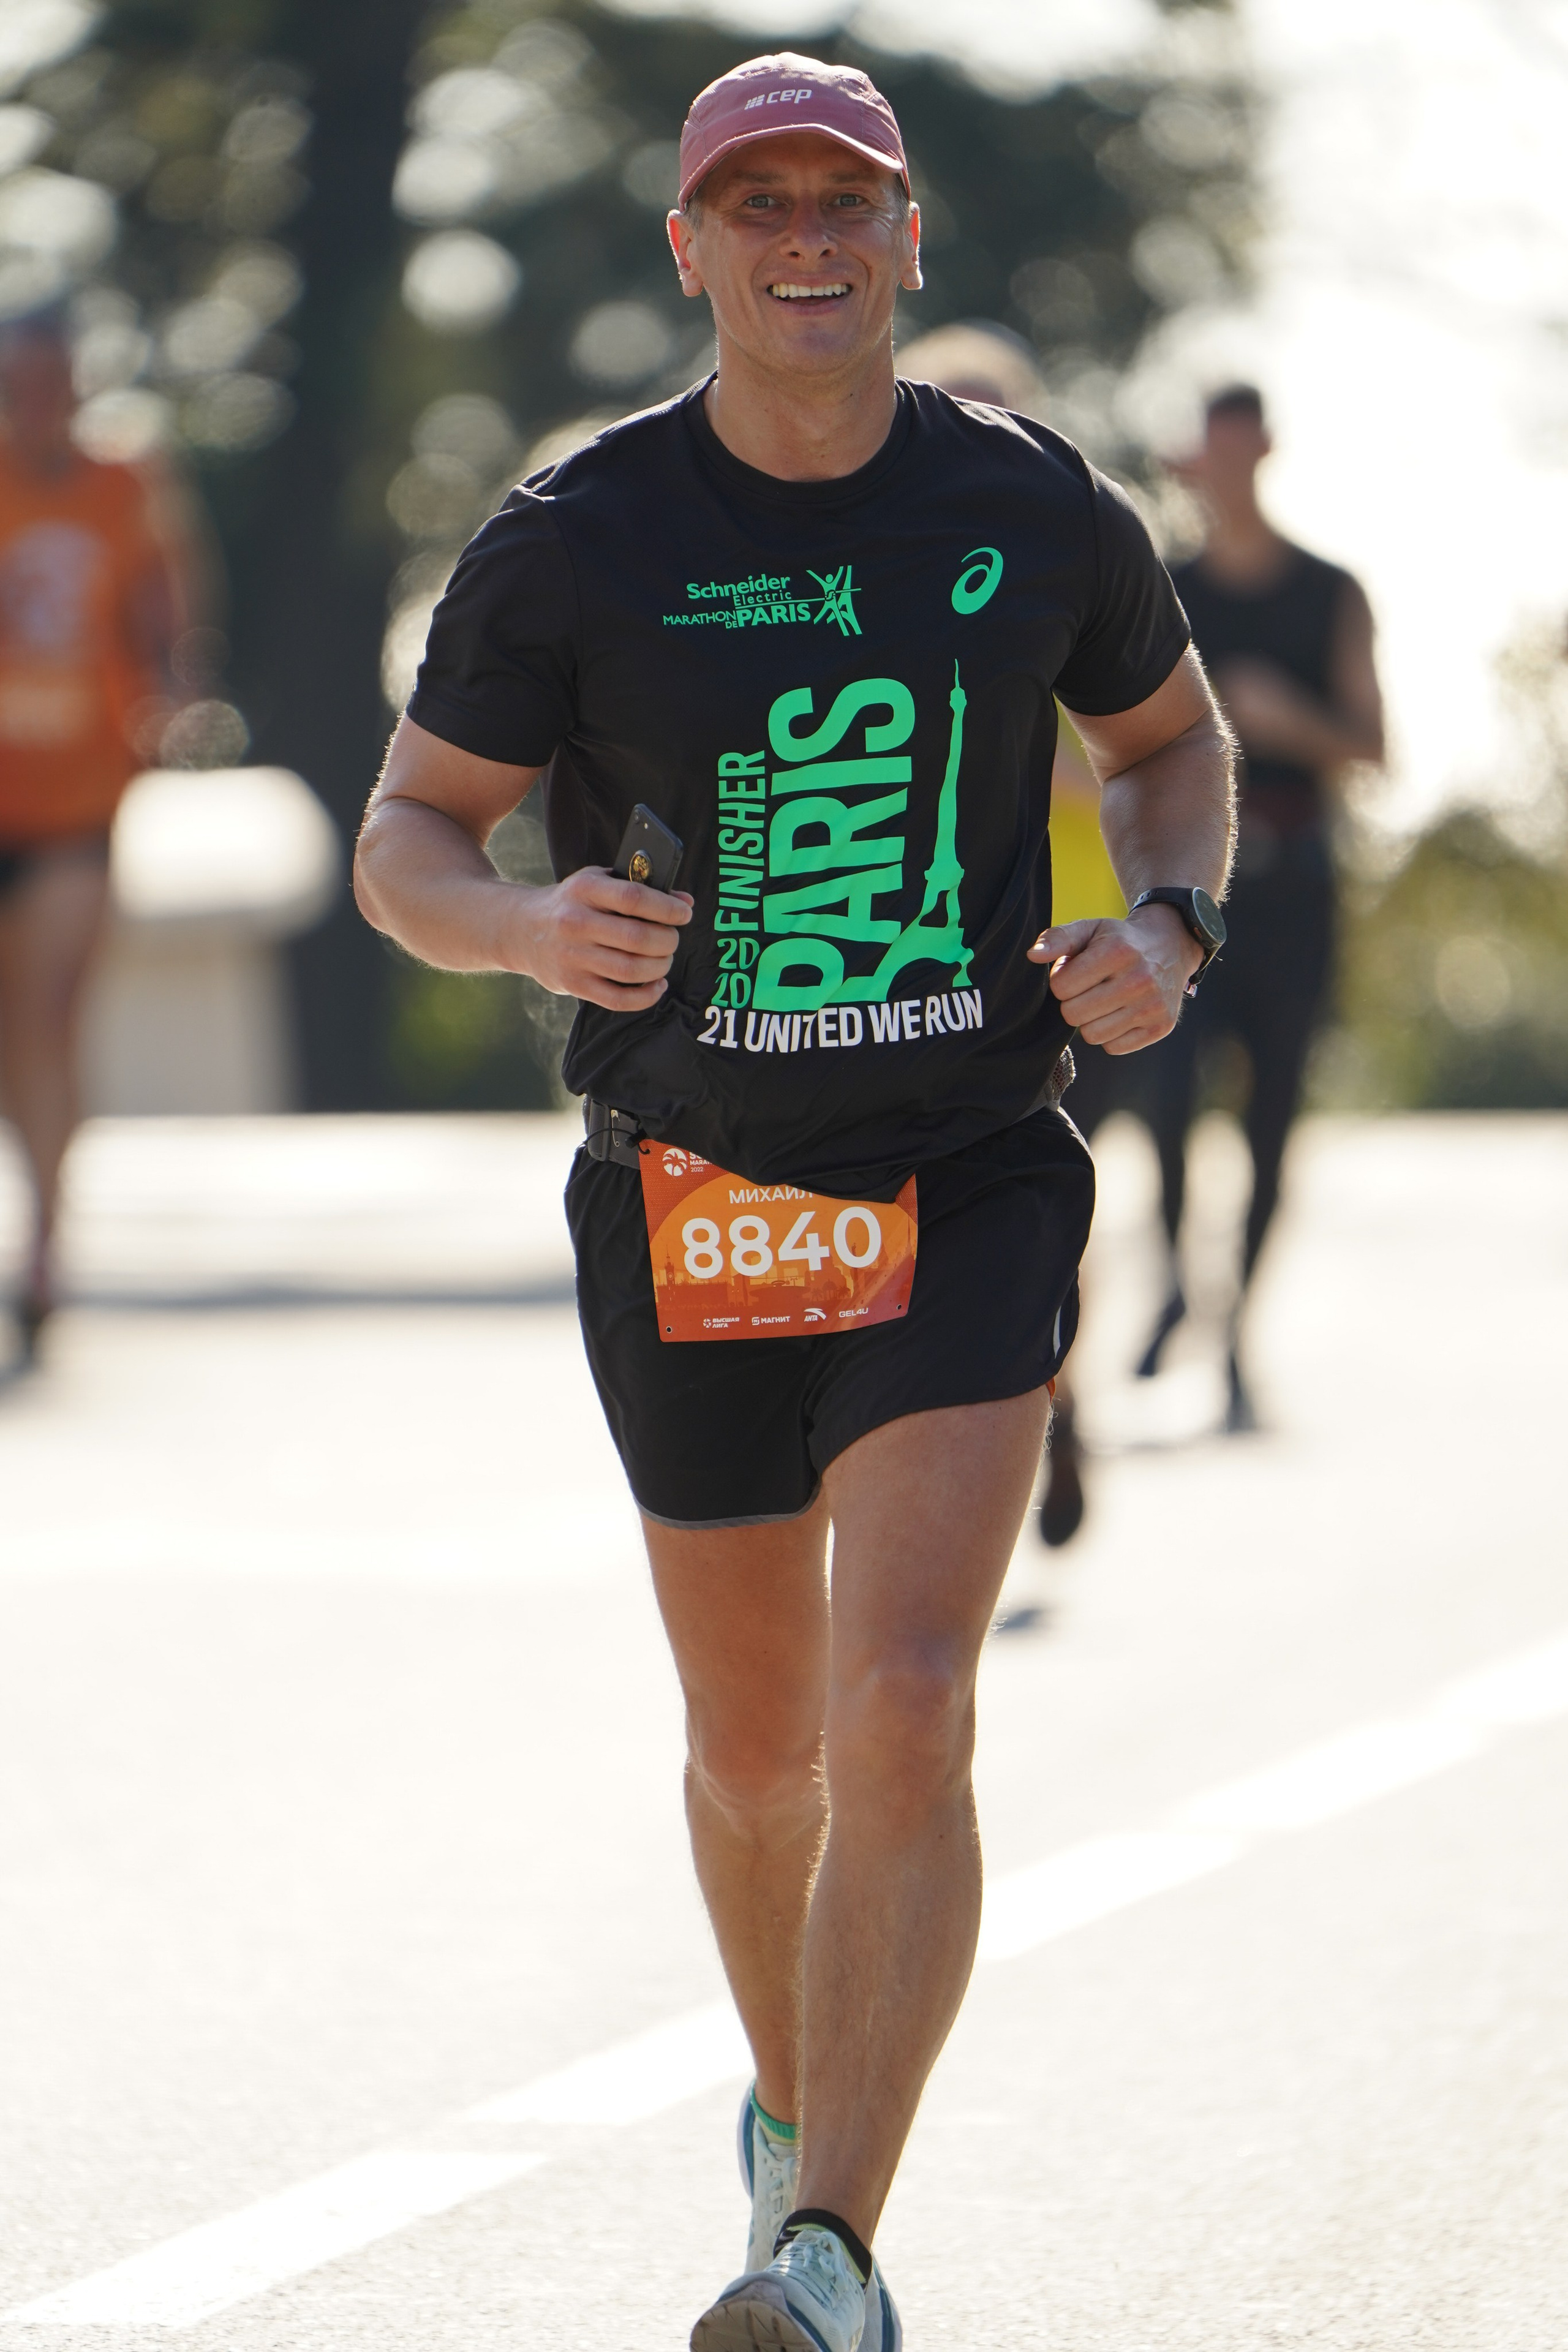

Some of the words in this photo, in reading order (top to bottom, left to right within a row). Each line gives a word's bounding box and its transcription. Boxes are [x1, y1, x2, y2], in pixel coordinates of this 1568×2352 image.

[766, 89, 812, 104] cep
[686, 573, 791, 600] Schneider
[733, 590, 792, 606] Electric
[663, 610, 736, 625] MARATHON
[725, 620, 738, 629] DE
[736, 603, 812, 627] PARIS
[714, 750, 766, 932] FINISHER
[752, 677, 915, 1012] PARIS
[717, 937, 760, 970] 20
[696, 1005, 737, 1049] 21
[744, 1006, 863, 1054] UNITED
[867, 1000, 921, 1044] WE
[925, 989, 983, 1036] RUN
[681, 1206, 881, 1279] 8840
[839, 1308, 869, 1318] GEL4U
